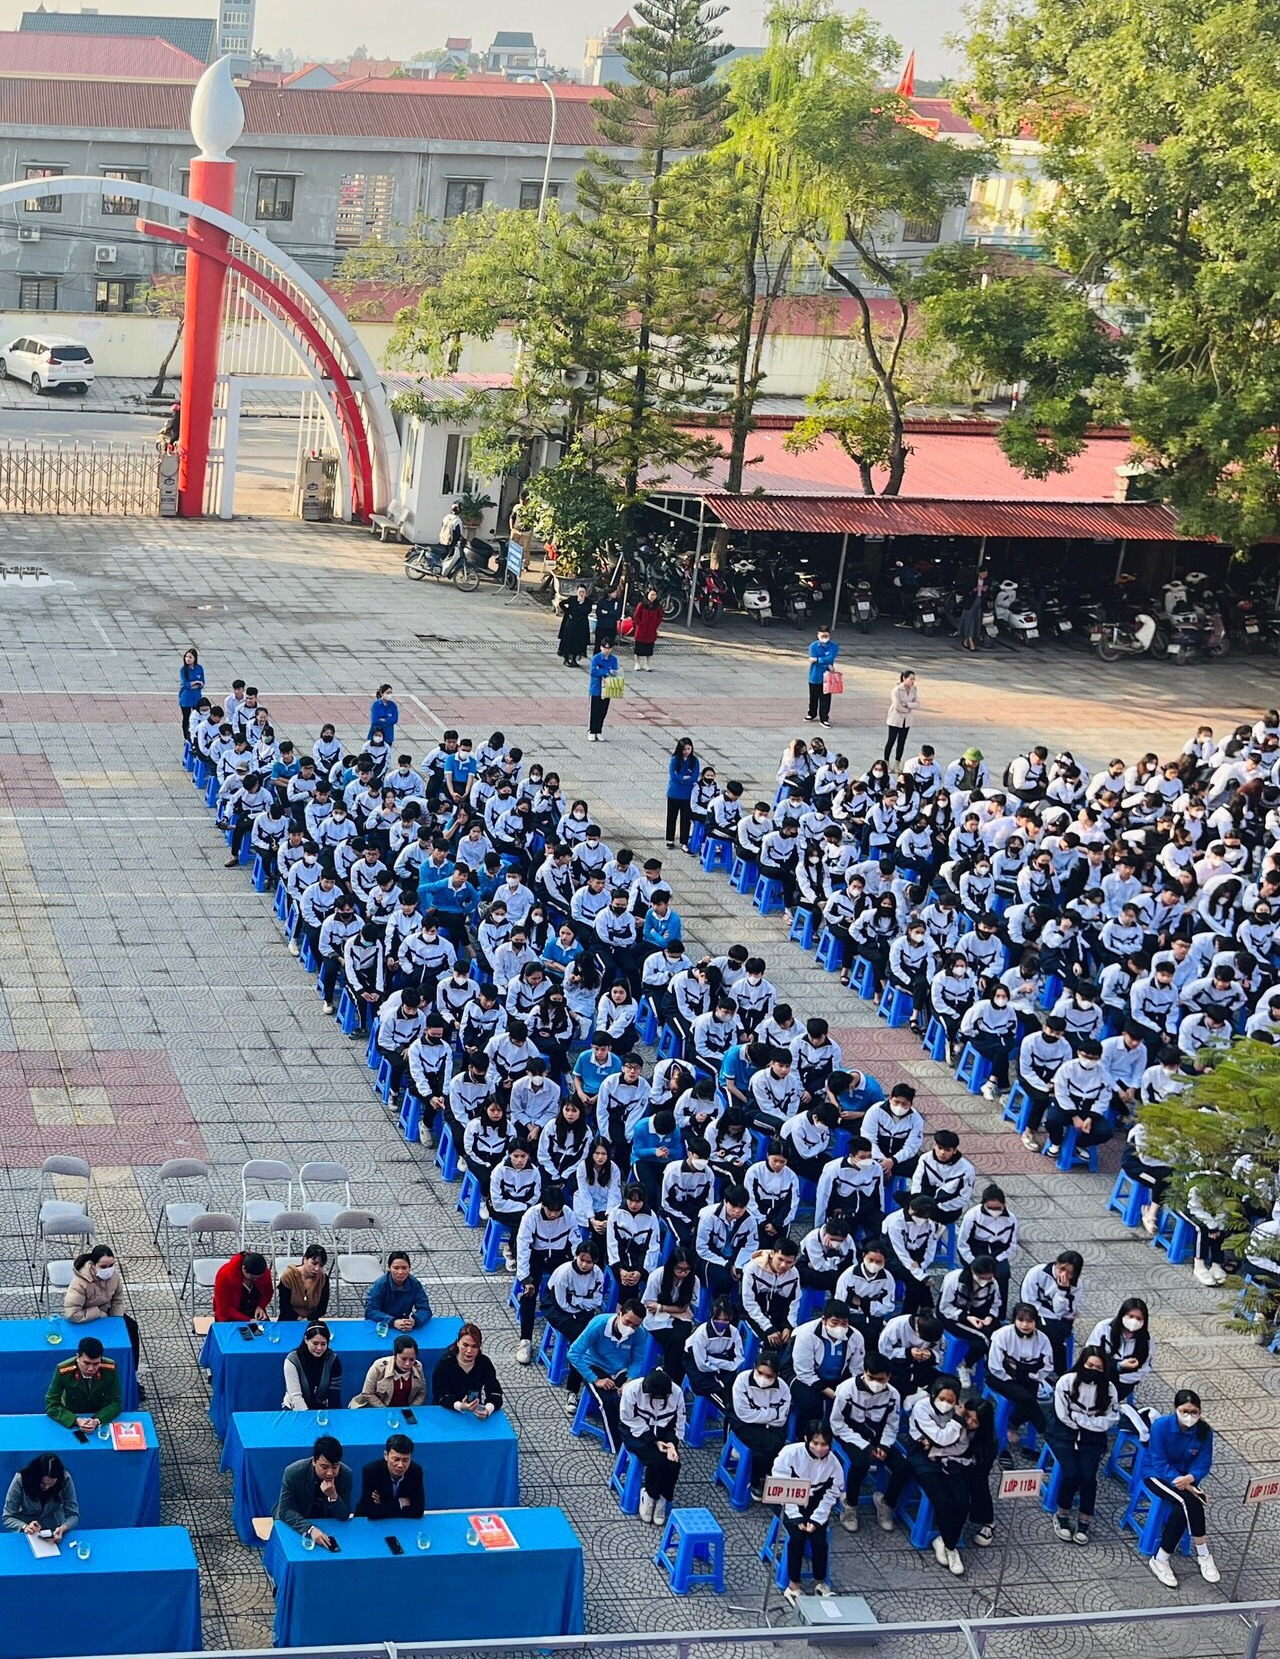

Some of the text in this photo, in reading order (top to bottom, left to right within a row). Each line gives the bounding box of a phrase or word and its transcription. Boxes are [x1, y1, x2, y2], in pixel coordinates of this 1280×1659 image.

[1019, 1479, 1037, 1492] 11B4
[1263, 1482, 1279, 1496] 11B5
[786, 1487, 807, 1499] 11B3
